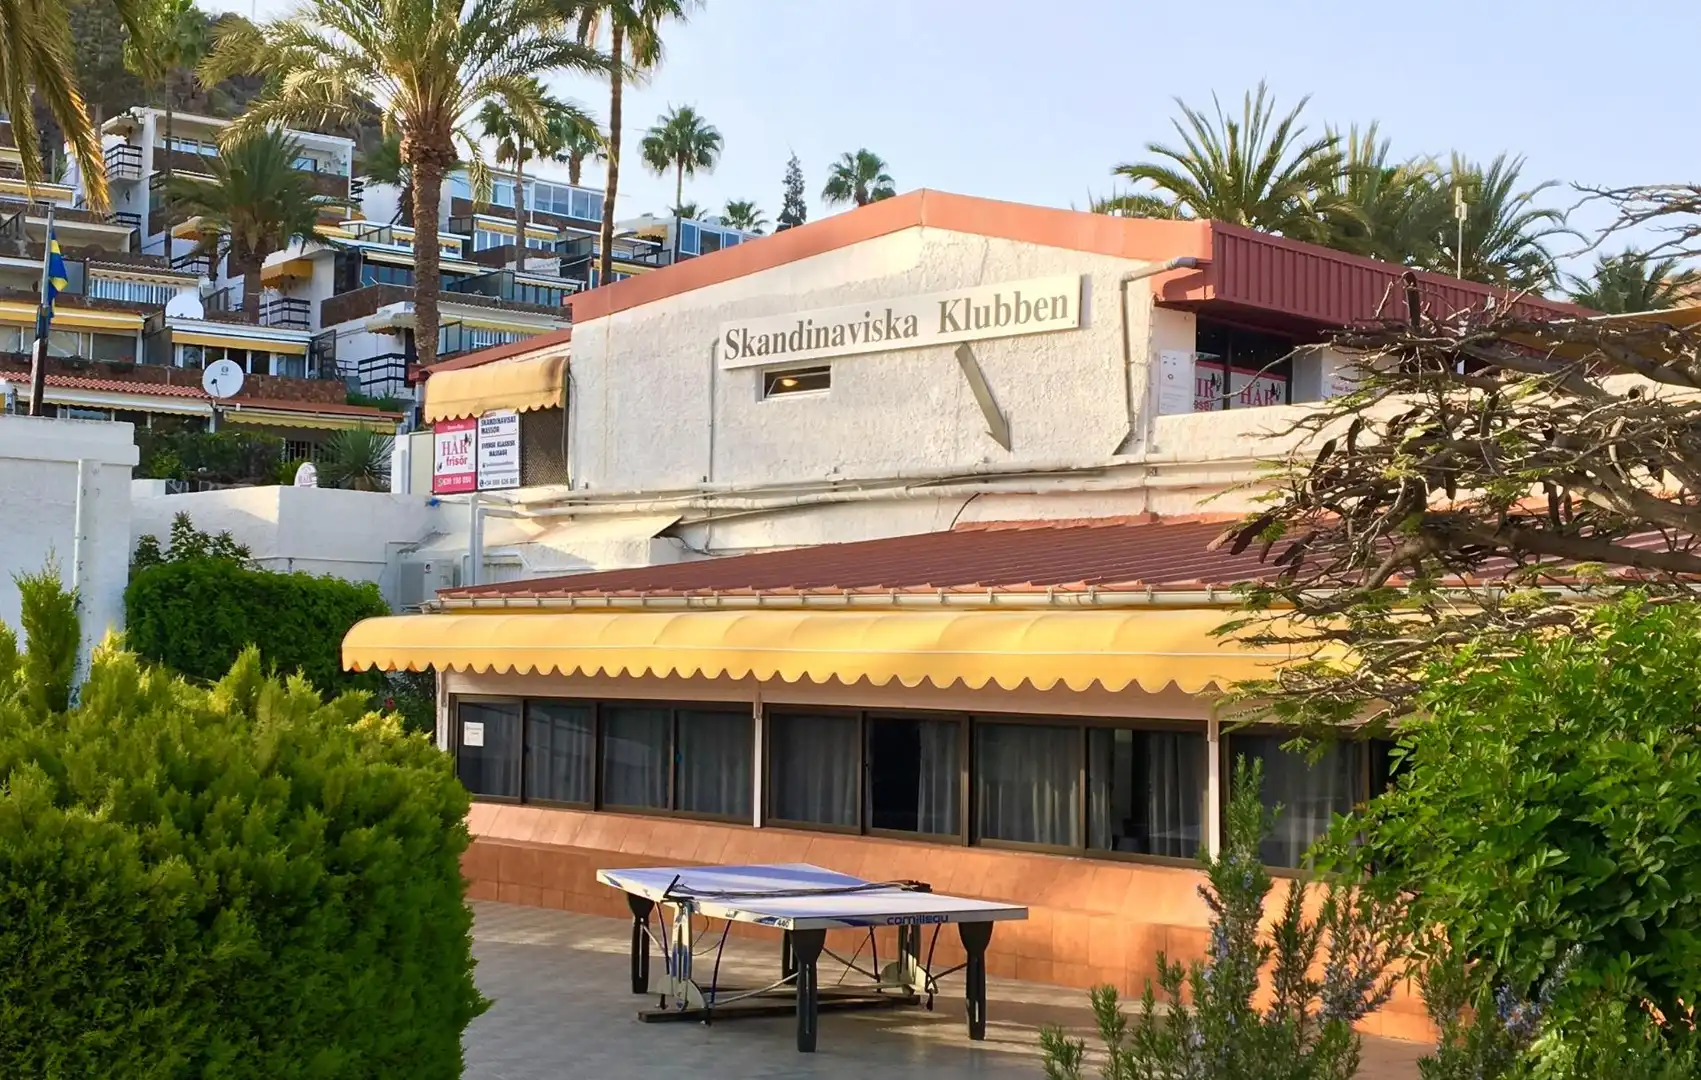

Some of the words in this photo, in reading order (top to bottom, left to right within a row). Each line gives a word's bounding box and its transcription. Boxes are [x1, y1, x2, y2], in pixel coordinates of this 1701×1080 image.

[724, 308, 919, 361] Skandinaviska
[938, 291, 1068, 335] Klubben
[441, 435, 468, 456] HÅR
[446, 456, 468, 467] frisör
